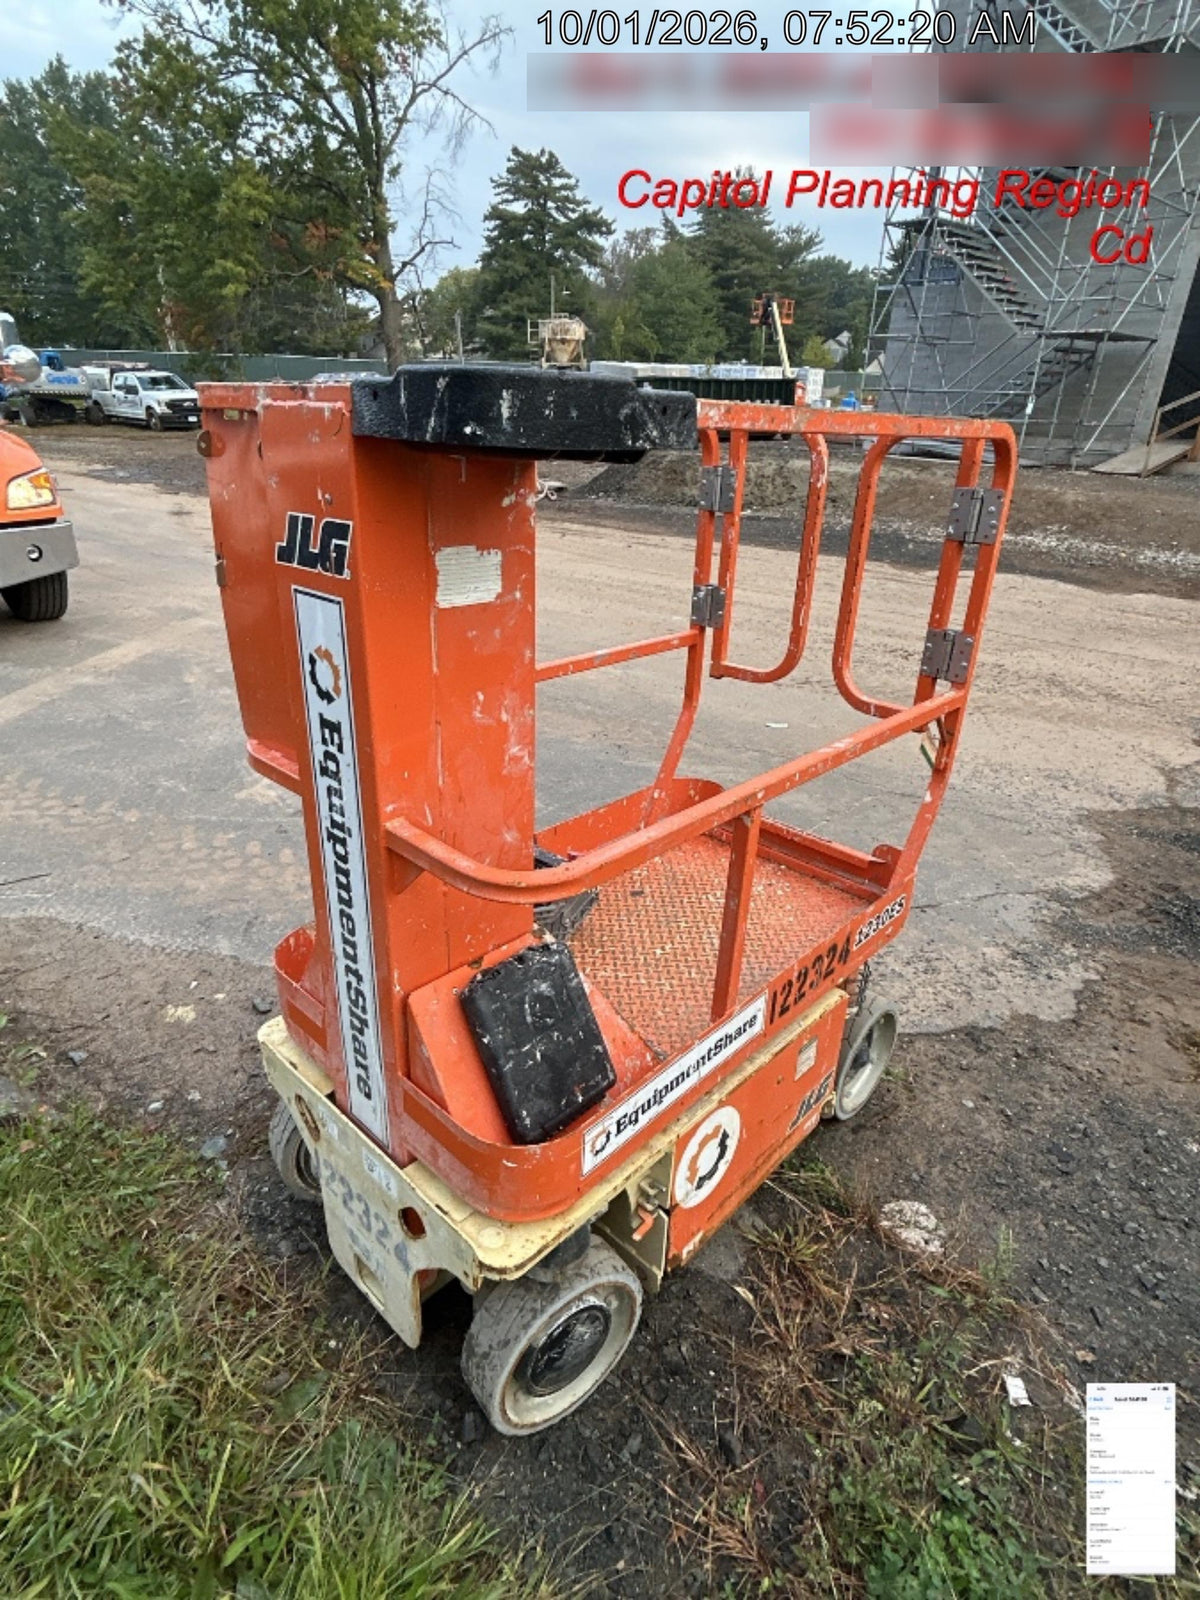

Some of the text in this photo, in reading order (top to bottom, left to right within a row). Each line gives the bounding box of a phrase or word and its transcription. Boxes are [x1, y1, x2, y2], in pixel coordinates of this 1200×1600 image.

[275, 512, 352, 579] JLG
[318, 712, 374, 1101] EquipmentShare
[769, 931, 851, 1025] 122324
